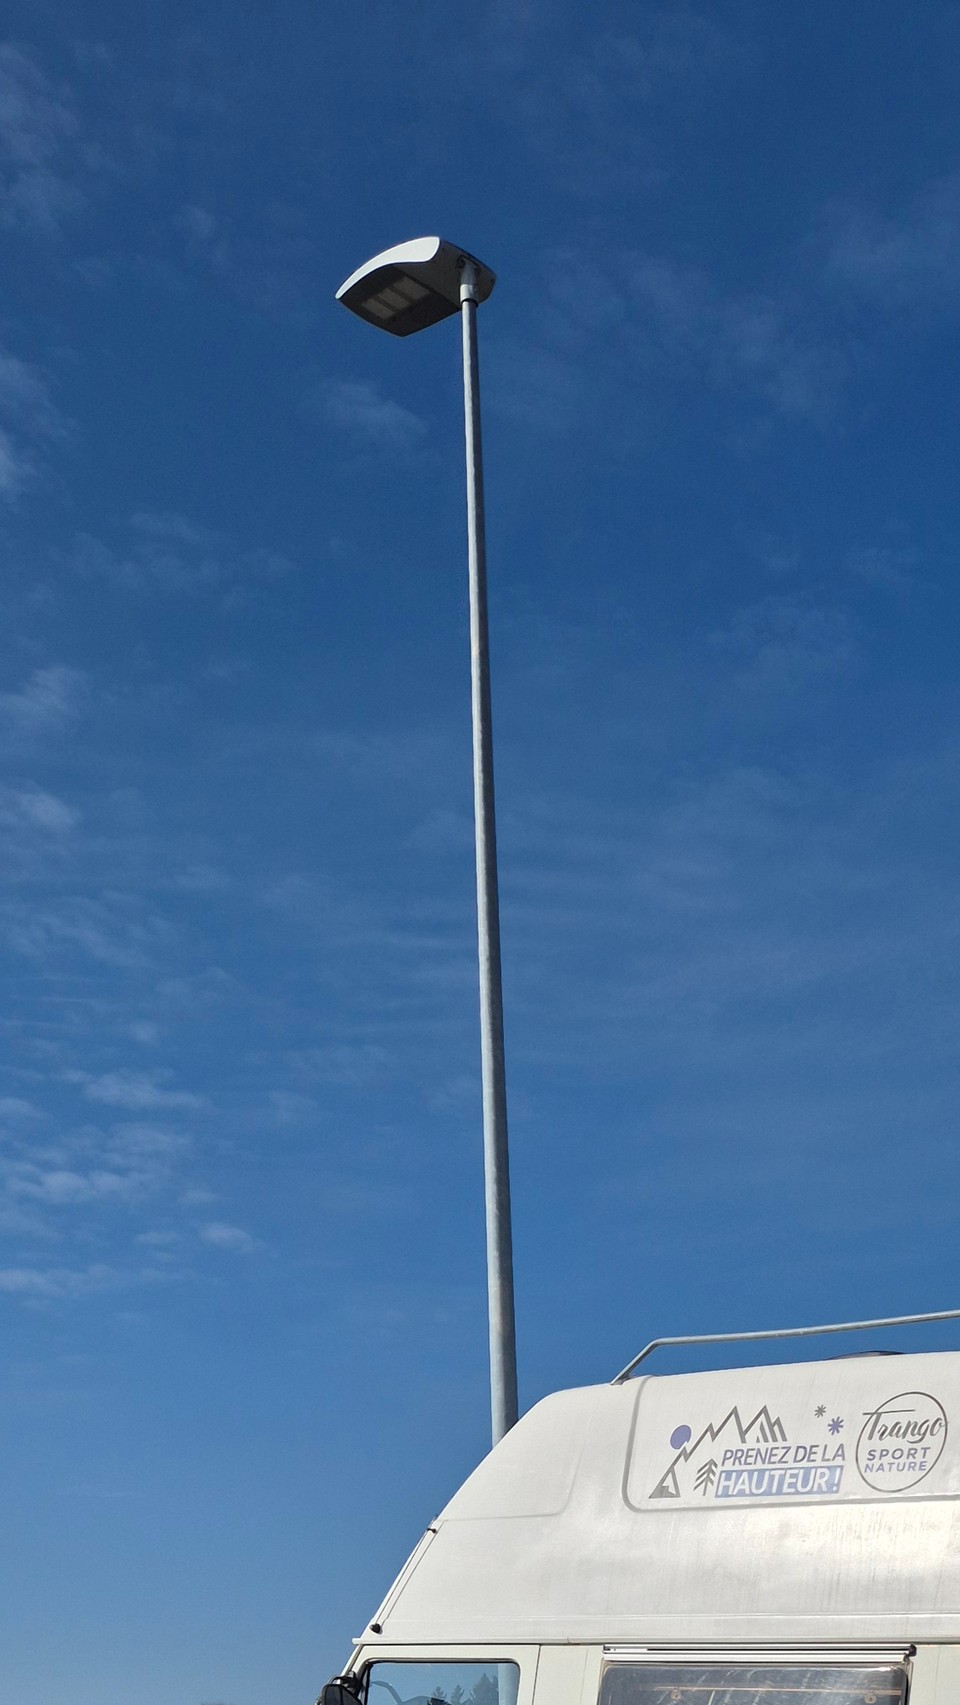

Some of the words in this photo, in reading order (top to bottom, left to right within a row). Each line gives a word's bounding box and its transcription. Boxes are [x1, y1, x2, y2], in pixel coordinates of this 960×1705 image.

[862, 1409, 945, 1444] Trango
[721, 1446, 792, 1467] PRENEZ
[793, 1444, 820, 1464] DE
[821, 1443, 846, 1462] LA
[866, 1446, 931, 1462] SPORT
[863, 1460, 928, 1474] NATURE
[717, 1467, 830, 1496] HAUTEUR
